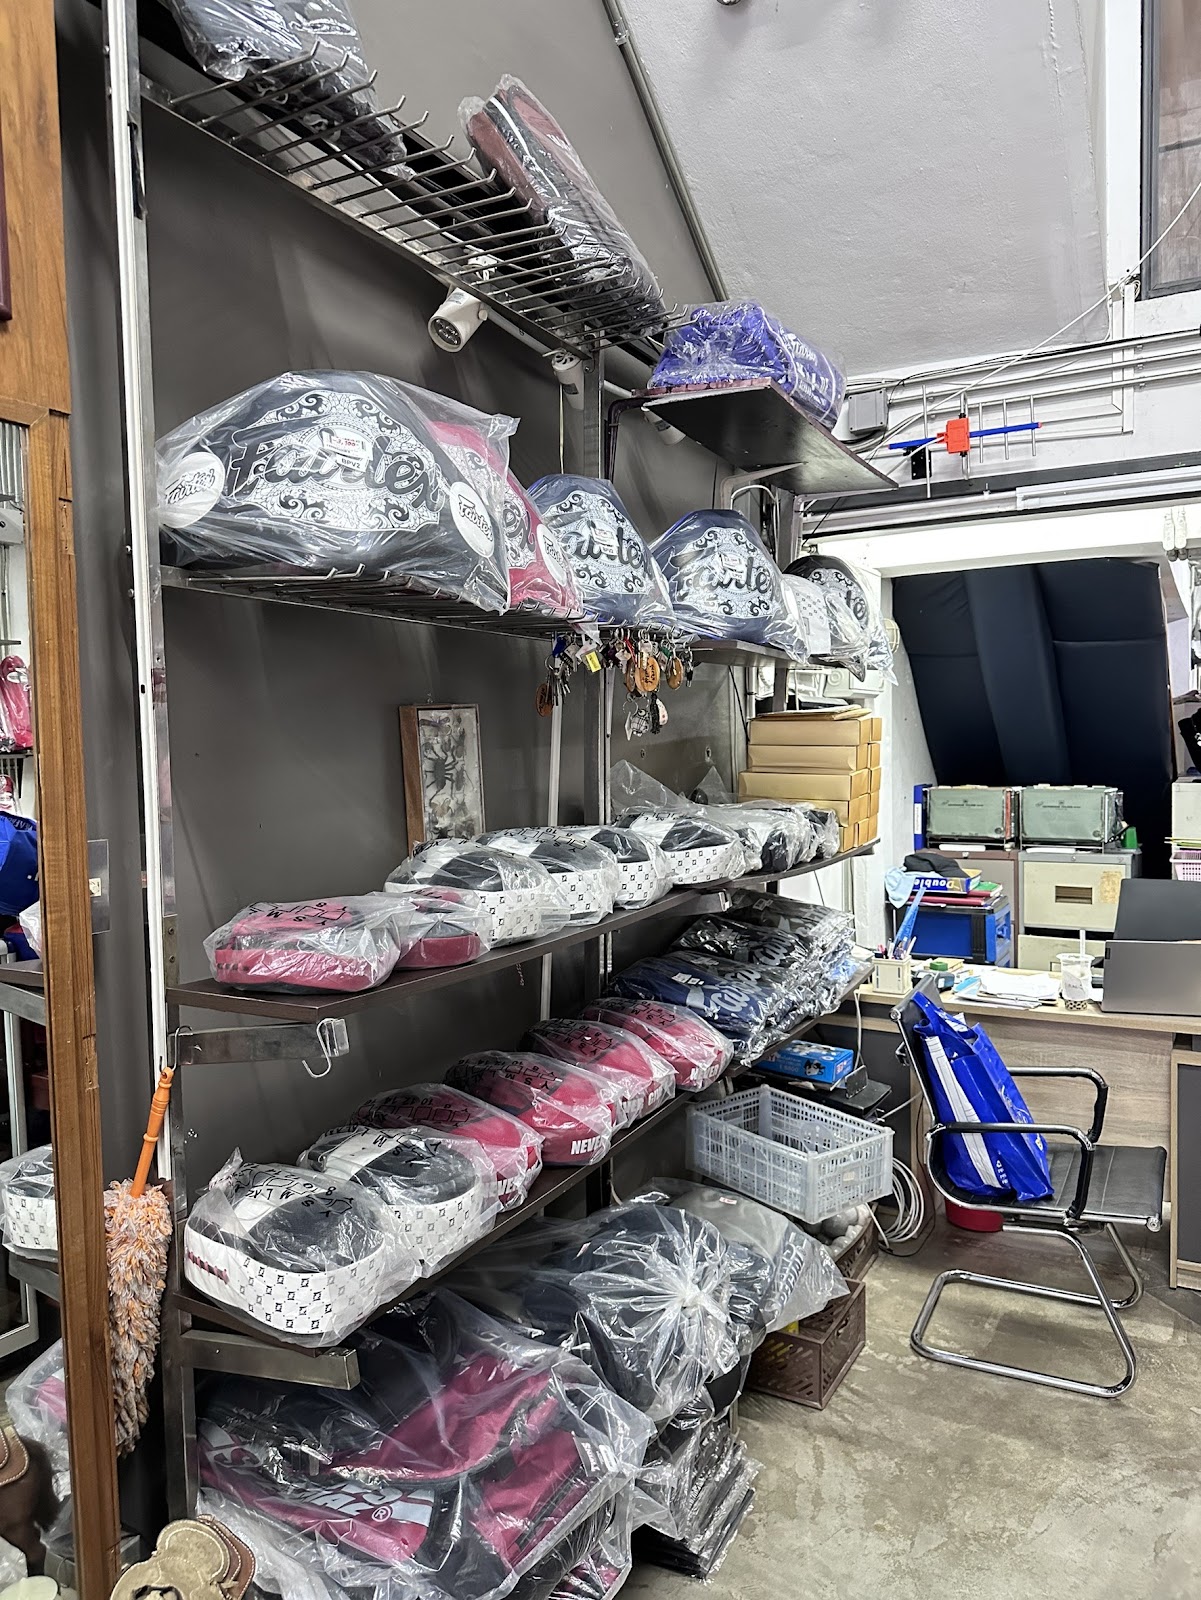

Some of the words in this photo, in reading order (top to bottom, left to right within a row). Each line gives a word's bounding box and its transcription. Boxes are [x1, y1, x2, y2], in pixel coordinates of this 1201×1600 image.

[914, 878, 955, 889] Double
[571, 1135, 604, 1155] NEVE
[326, 1186, 336, 1196] 8
